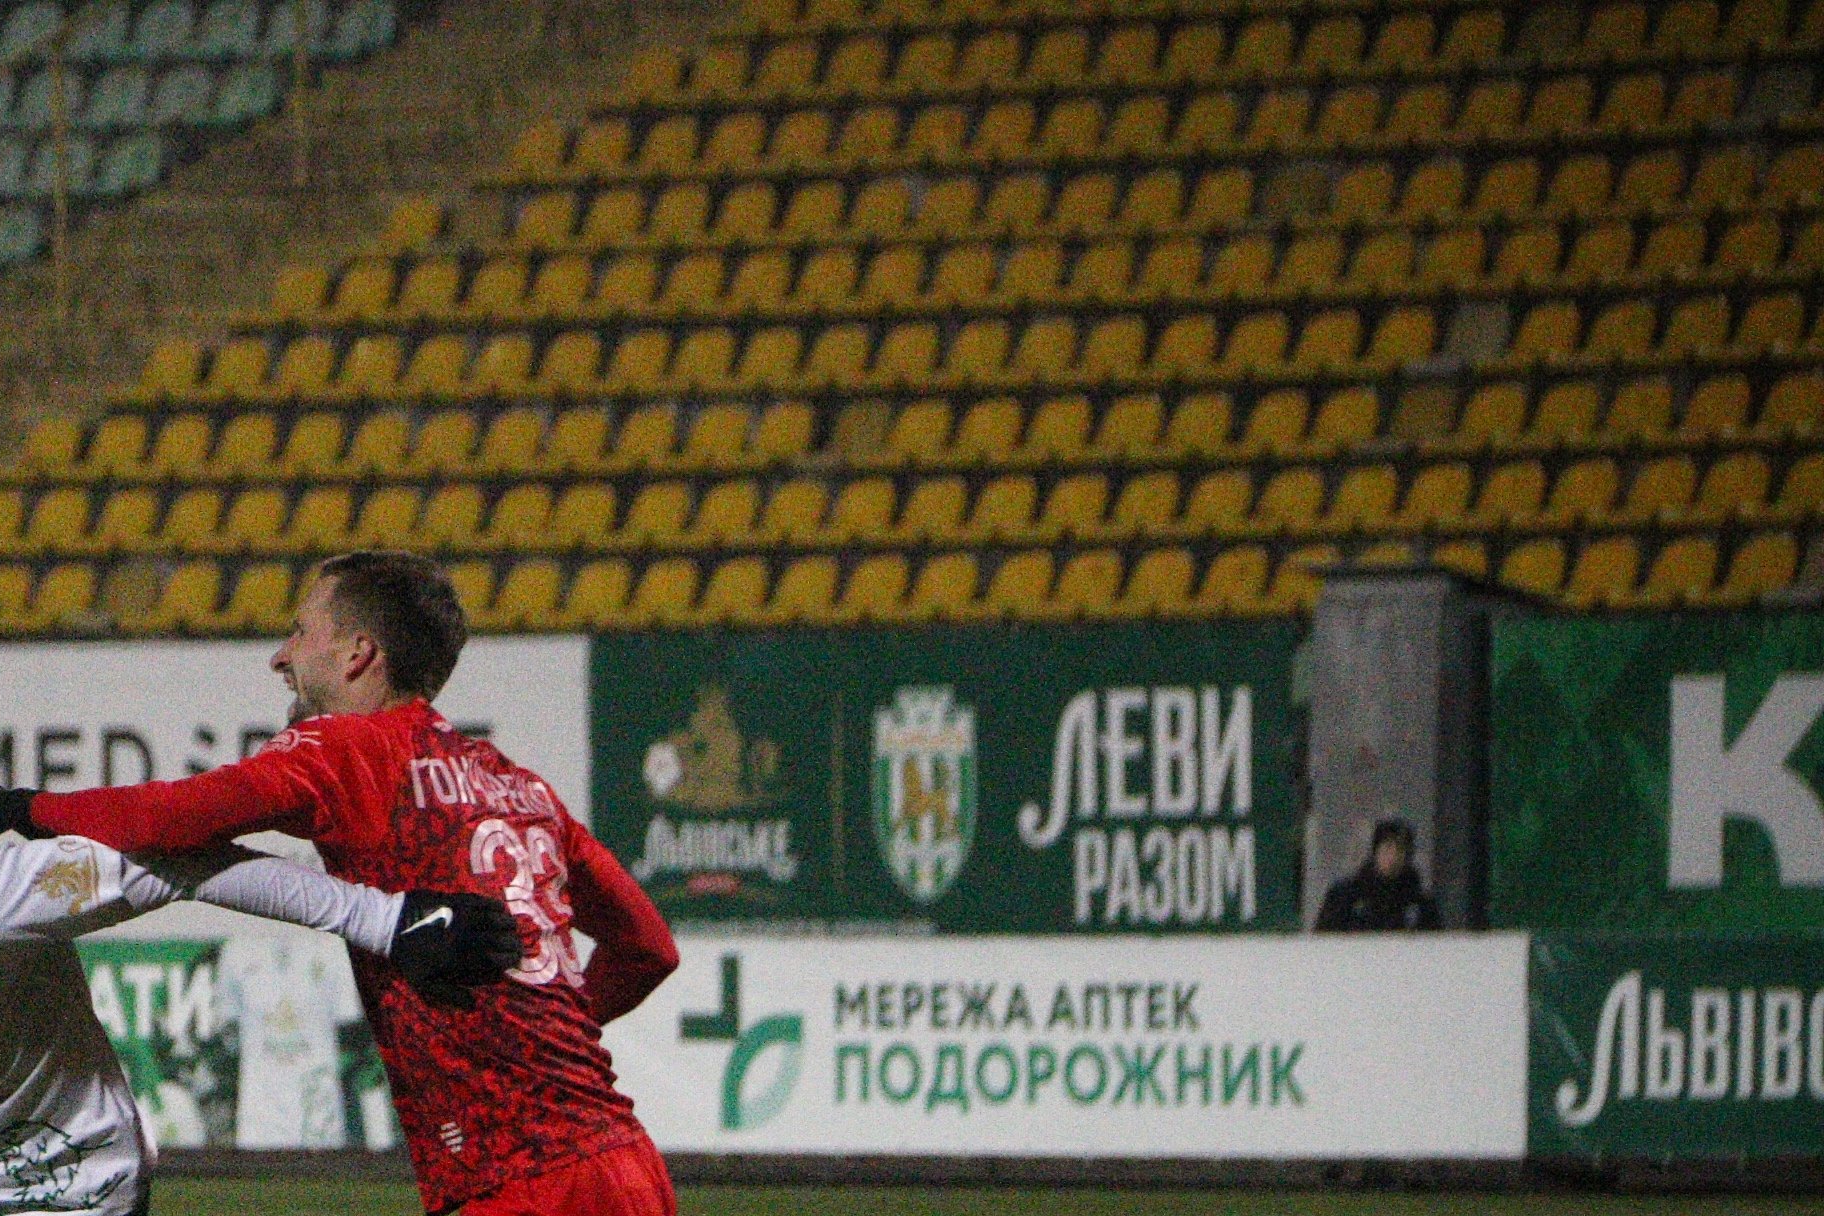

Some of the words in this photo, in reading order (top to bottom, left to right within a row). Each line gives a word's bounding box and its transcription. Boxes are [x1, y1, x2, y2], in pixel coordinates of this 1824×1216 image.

[1018, 684, 1253, 848] ЛЕВИ
[1078, 826, 1256, 925] РАЗОМ
[833, 981, 1033, 1032] МЕРЕЖА
[1047, 981, 1201, 1032] АПТЕК
[833, 1042, 1306, 1112] ПОДОРОЖНИК
